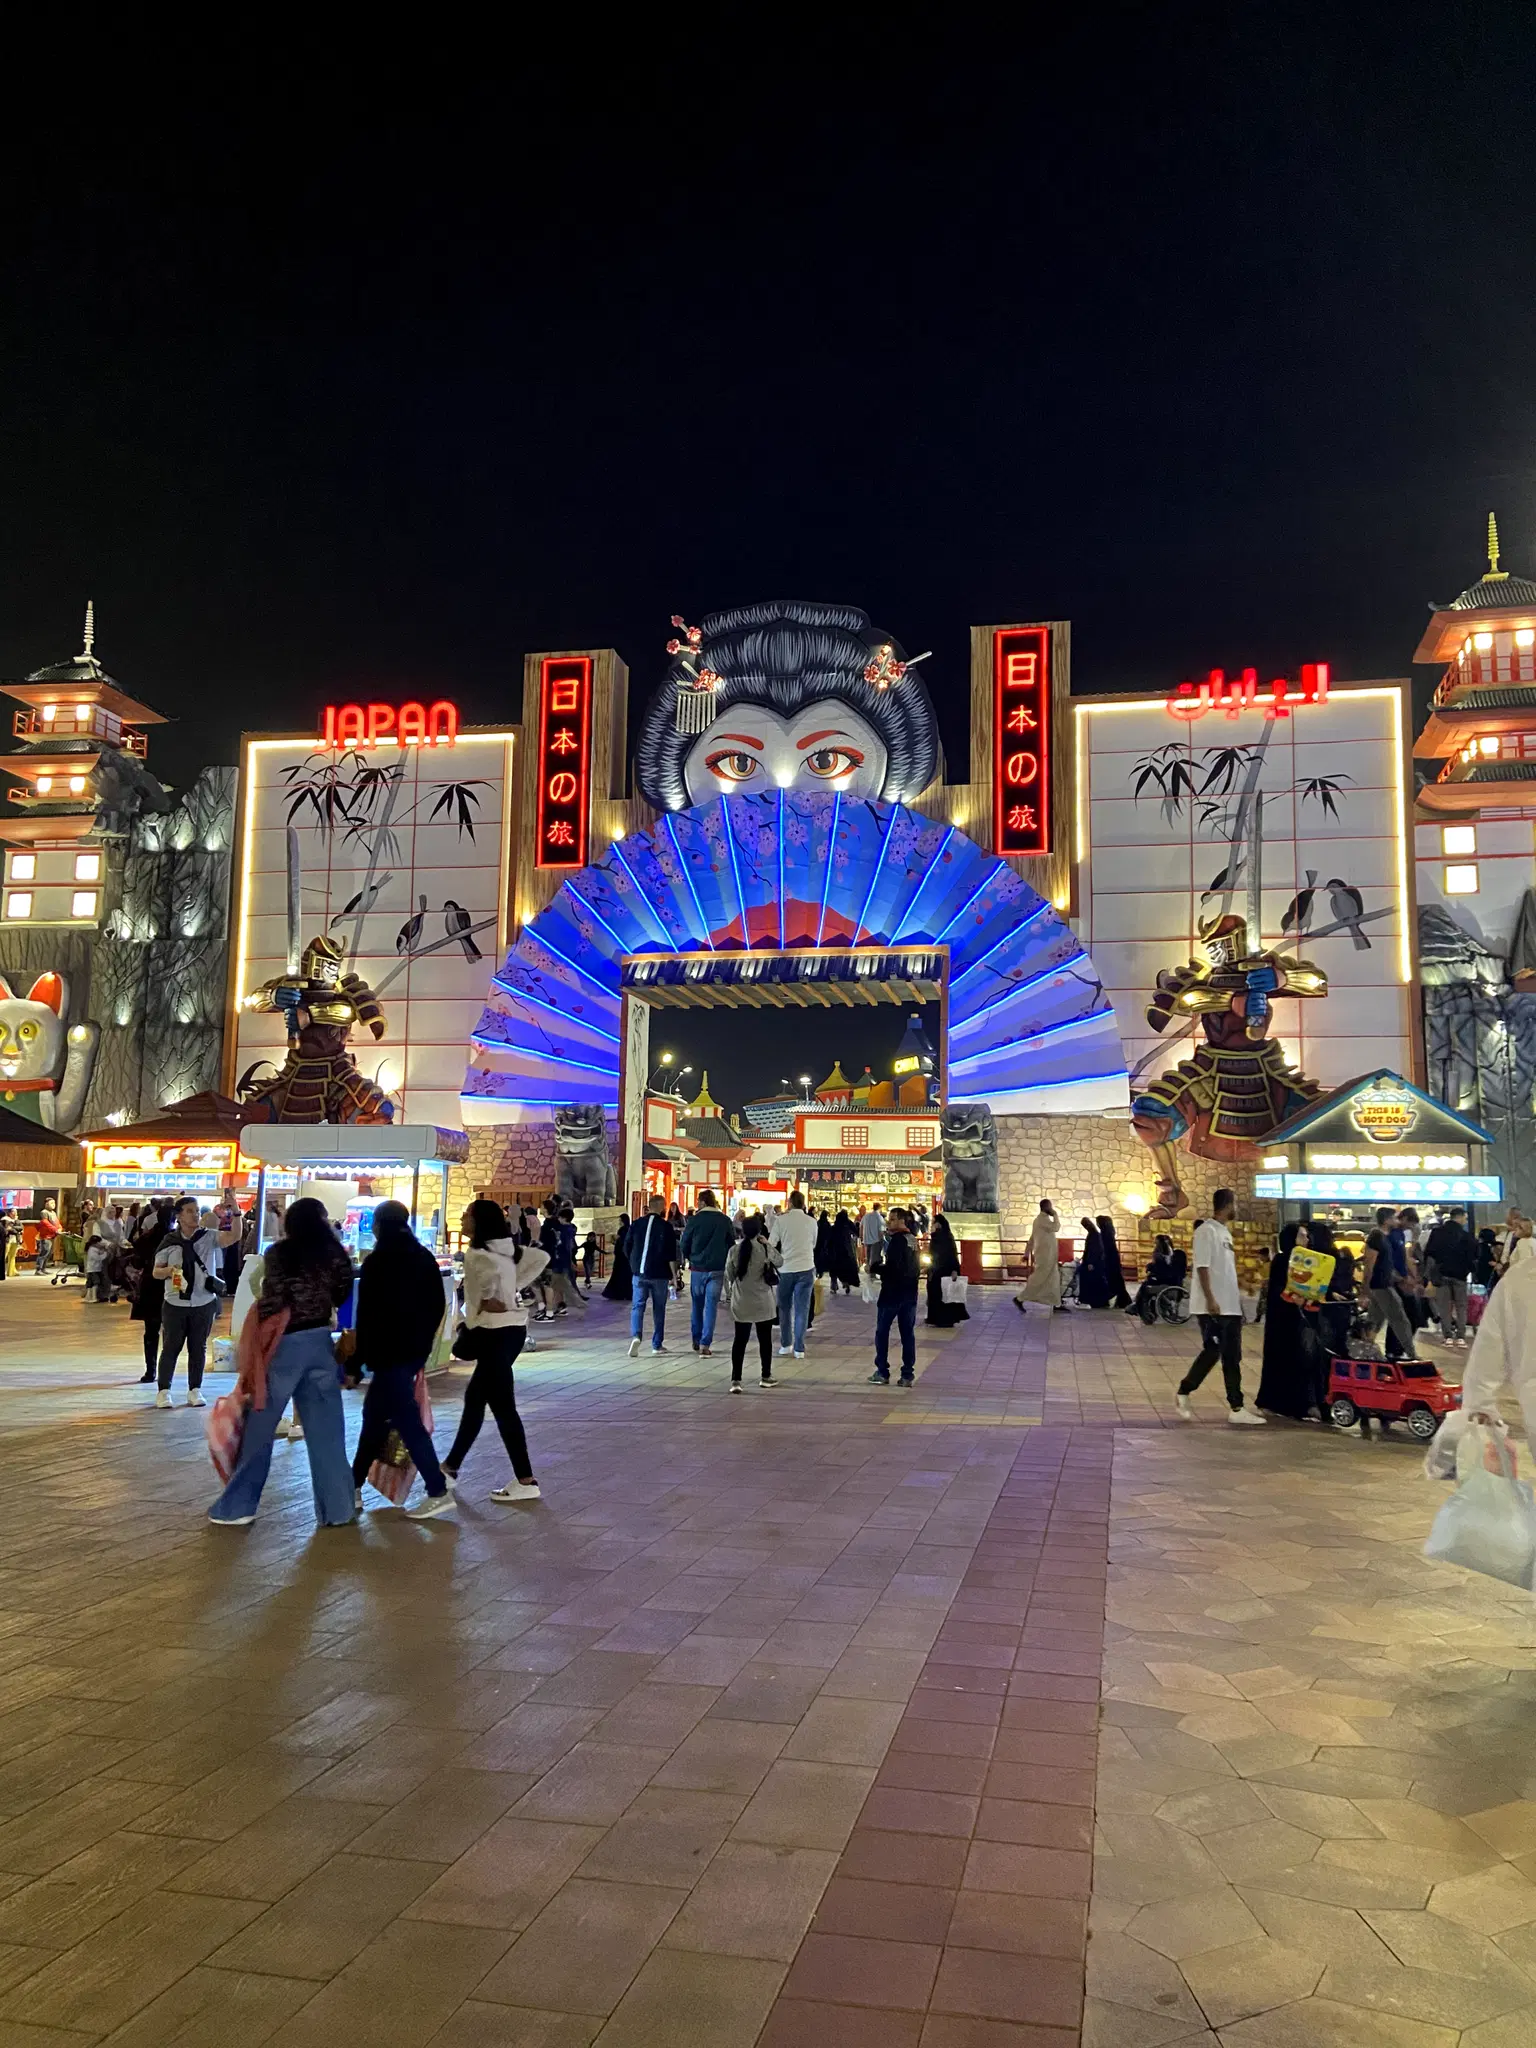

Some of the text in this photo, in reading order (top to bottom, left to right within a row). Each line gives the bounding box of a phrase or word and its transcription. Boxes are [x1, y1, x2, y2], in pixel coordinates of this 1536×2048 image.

[1166, 664, 1329, 720] اليابان
[312, 701, 457, 752] JAPAN
[1007, 653, 1038, 830] 日本の旅
[547, 679, 580, 844] 日本の旅
[1366, 1106, 1401, 1114] THIS IS
